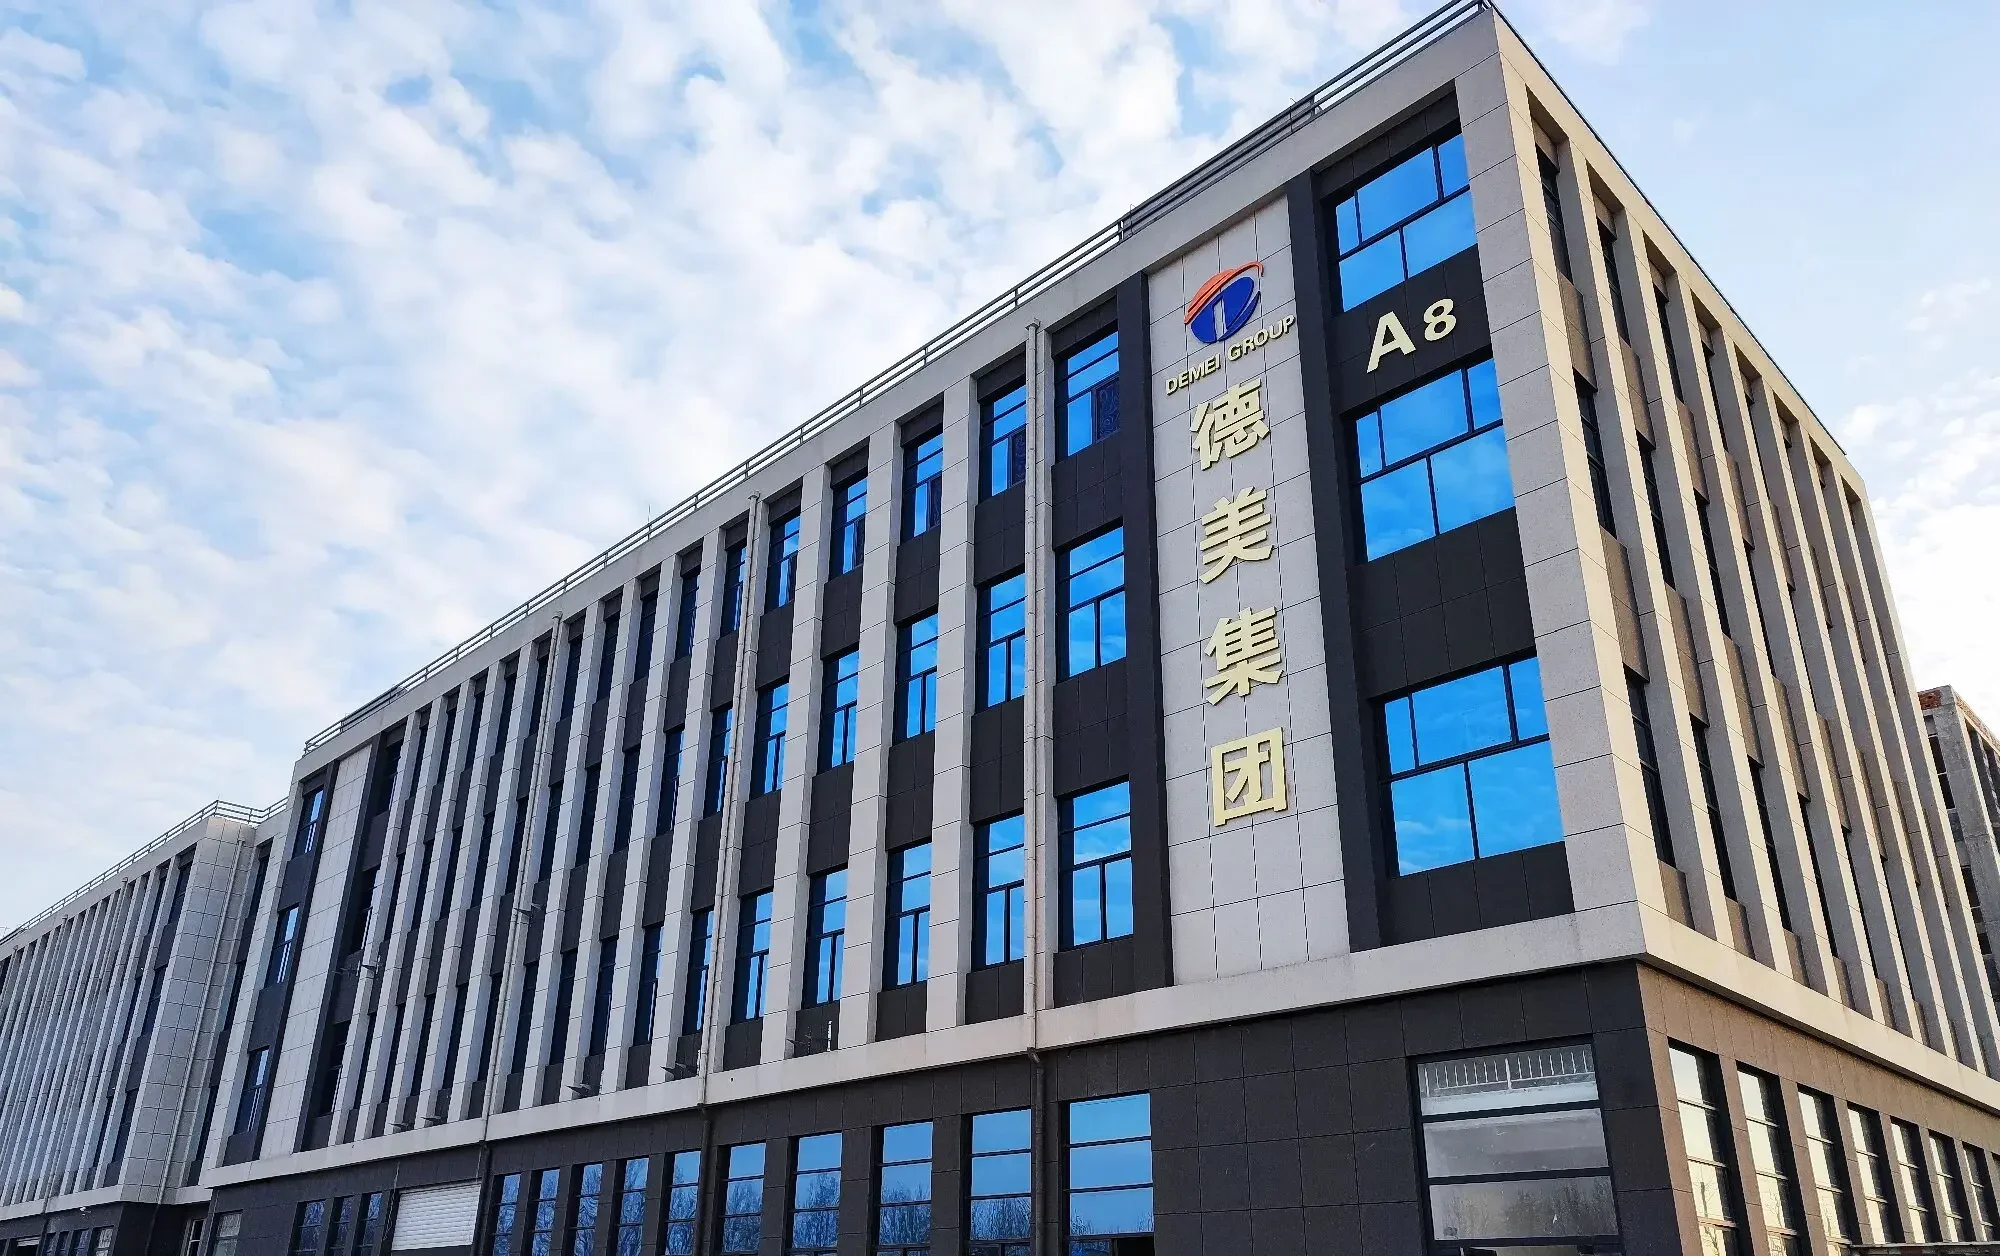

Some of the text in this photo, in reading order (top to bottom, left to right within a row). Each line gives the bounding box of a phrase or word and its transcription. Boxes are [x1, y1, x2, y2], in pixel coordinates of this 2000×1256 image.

[1165, 314, 1296, 395] DEMEI GROUP
[1190, 378, 1287, 827] 德美集团
